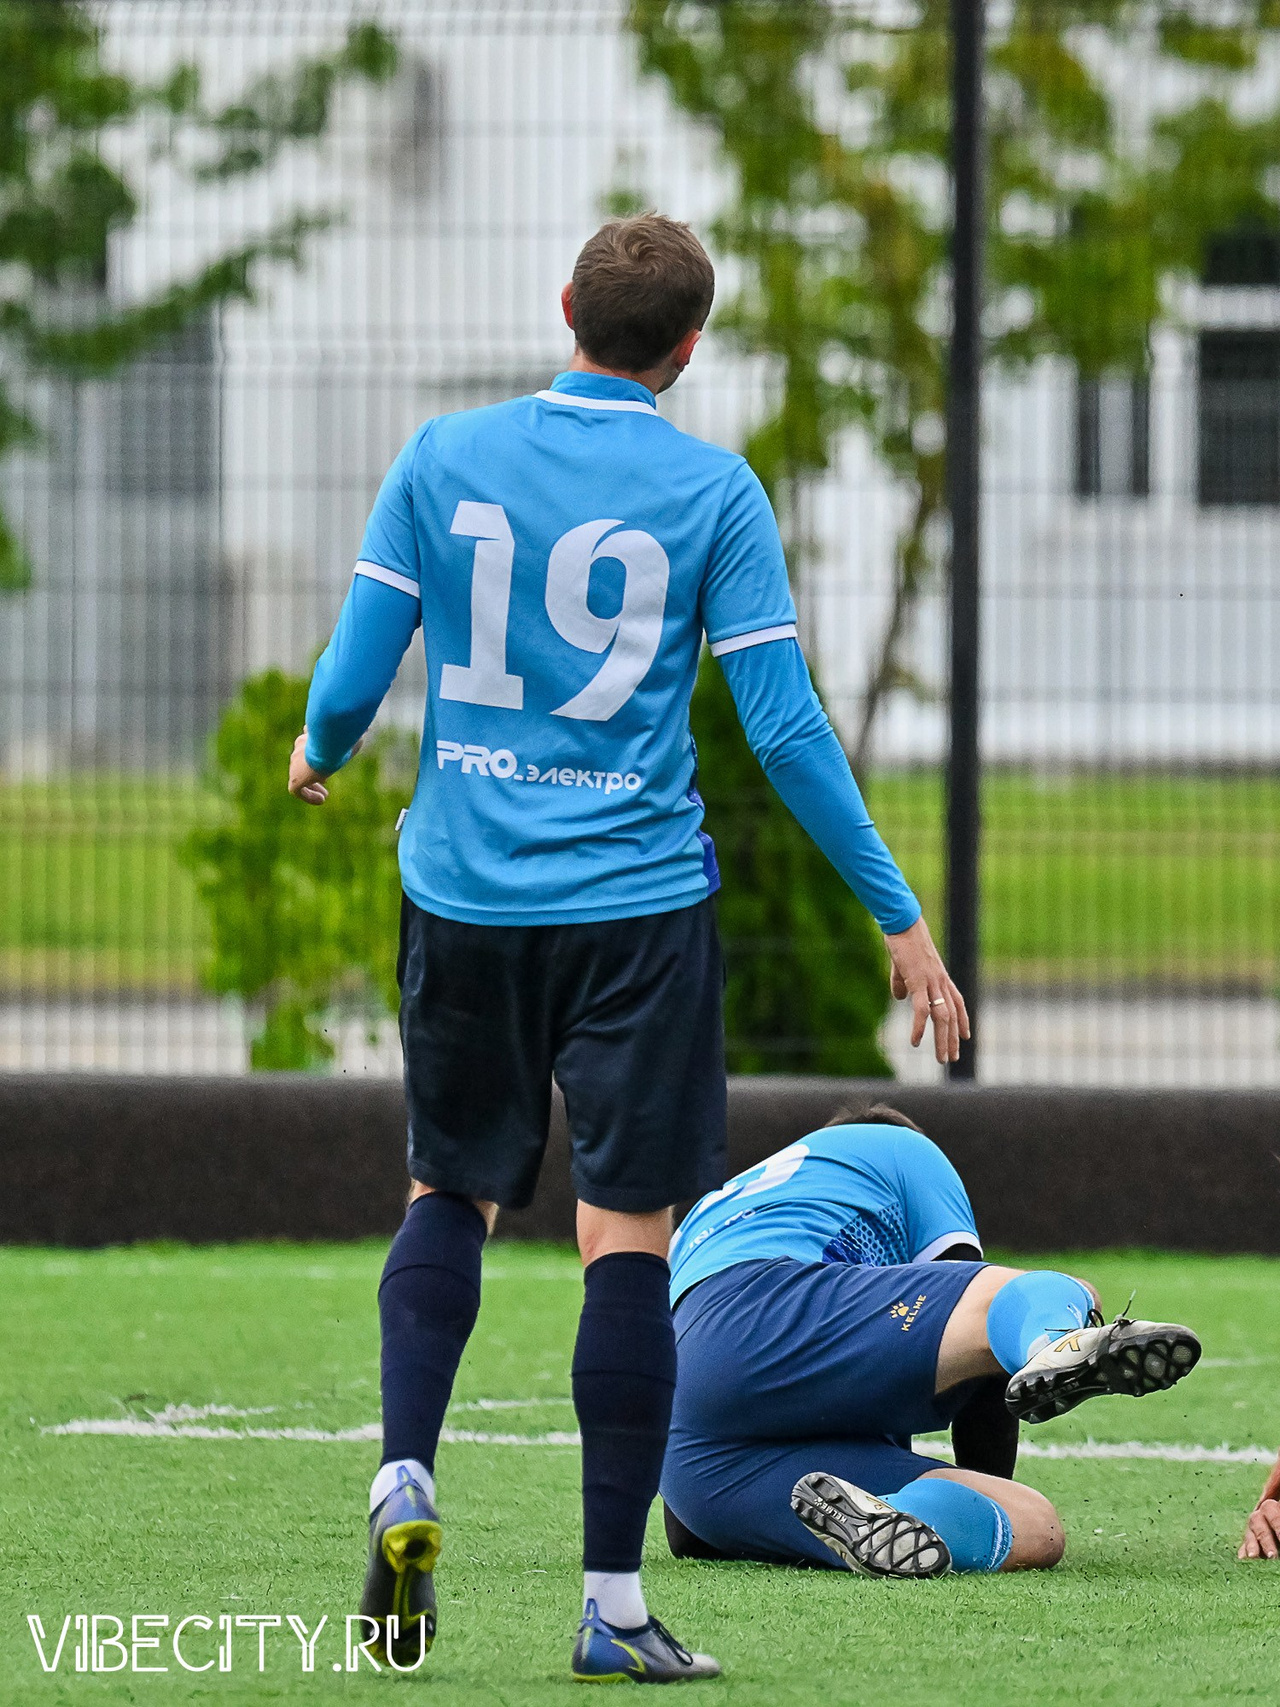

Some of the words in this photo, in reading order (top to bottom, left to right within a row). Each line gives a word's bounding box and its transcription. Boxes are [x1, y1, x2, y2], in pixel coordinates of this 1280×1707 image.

[439, 500, 670, 721] 19
[901, 1294, 927, 1331] KELME
[821, 1502, 848, 1524] KELME
